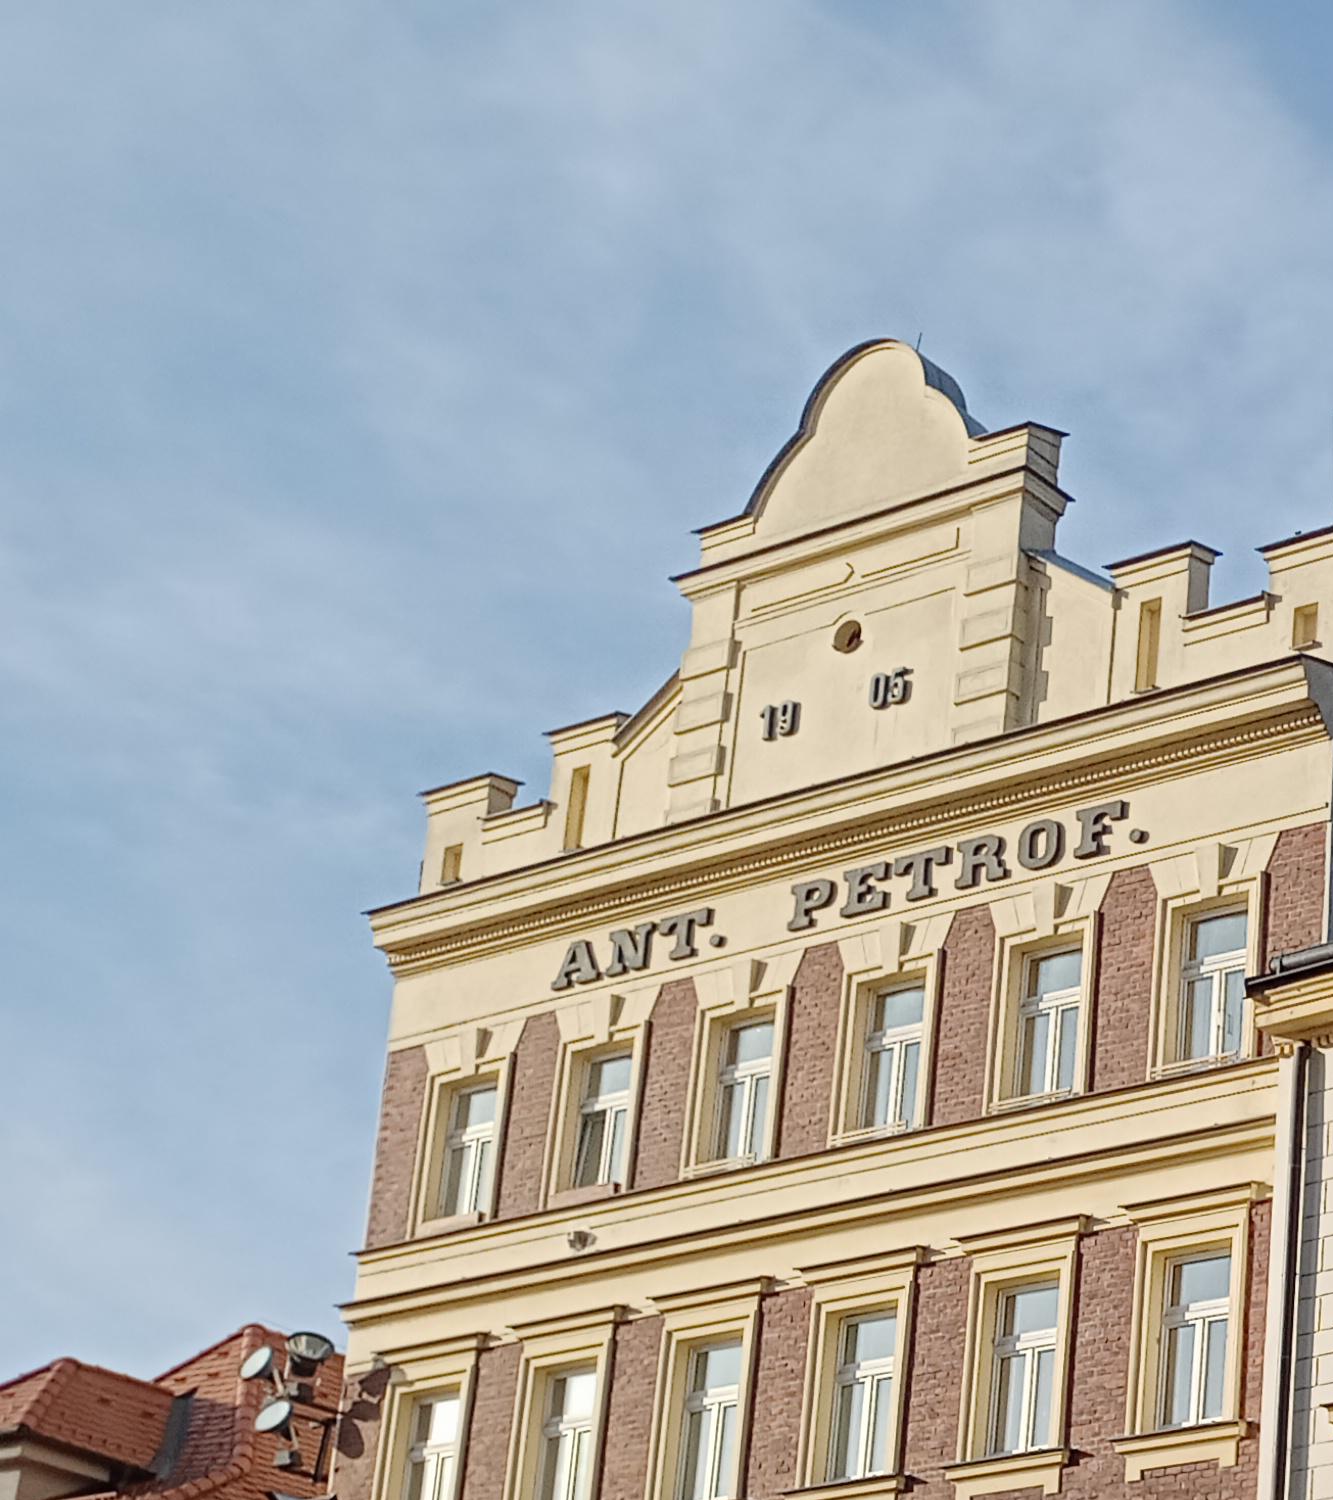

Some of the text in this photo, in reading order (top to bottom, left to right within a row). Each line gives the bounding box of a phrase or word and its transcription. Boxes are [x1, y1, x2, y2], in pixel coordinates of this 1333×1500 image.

[759, 667, 914, 742] 19 05
[551, 800, 1150, 991] ANT. PETROF.
